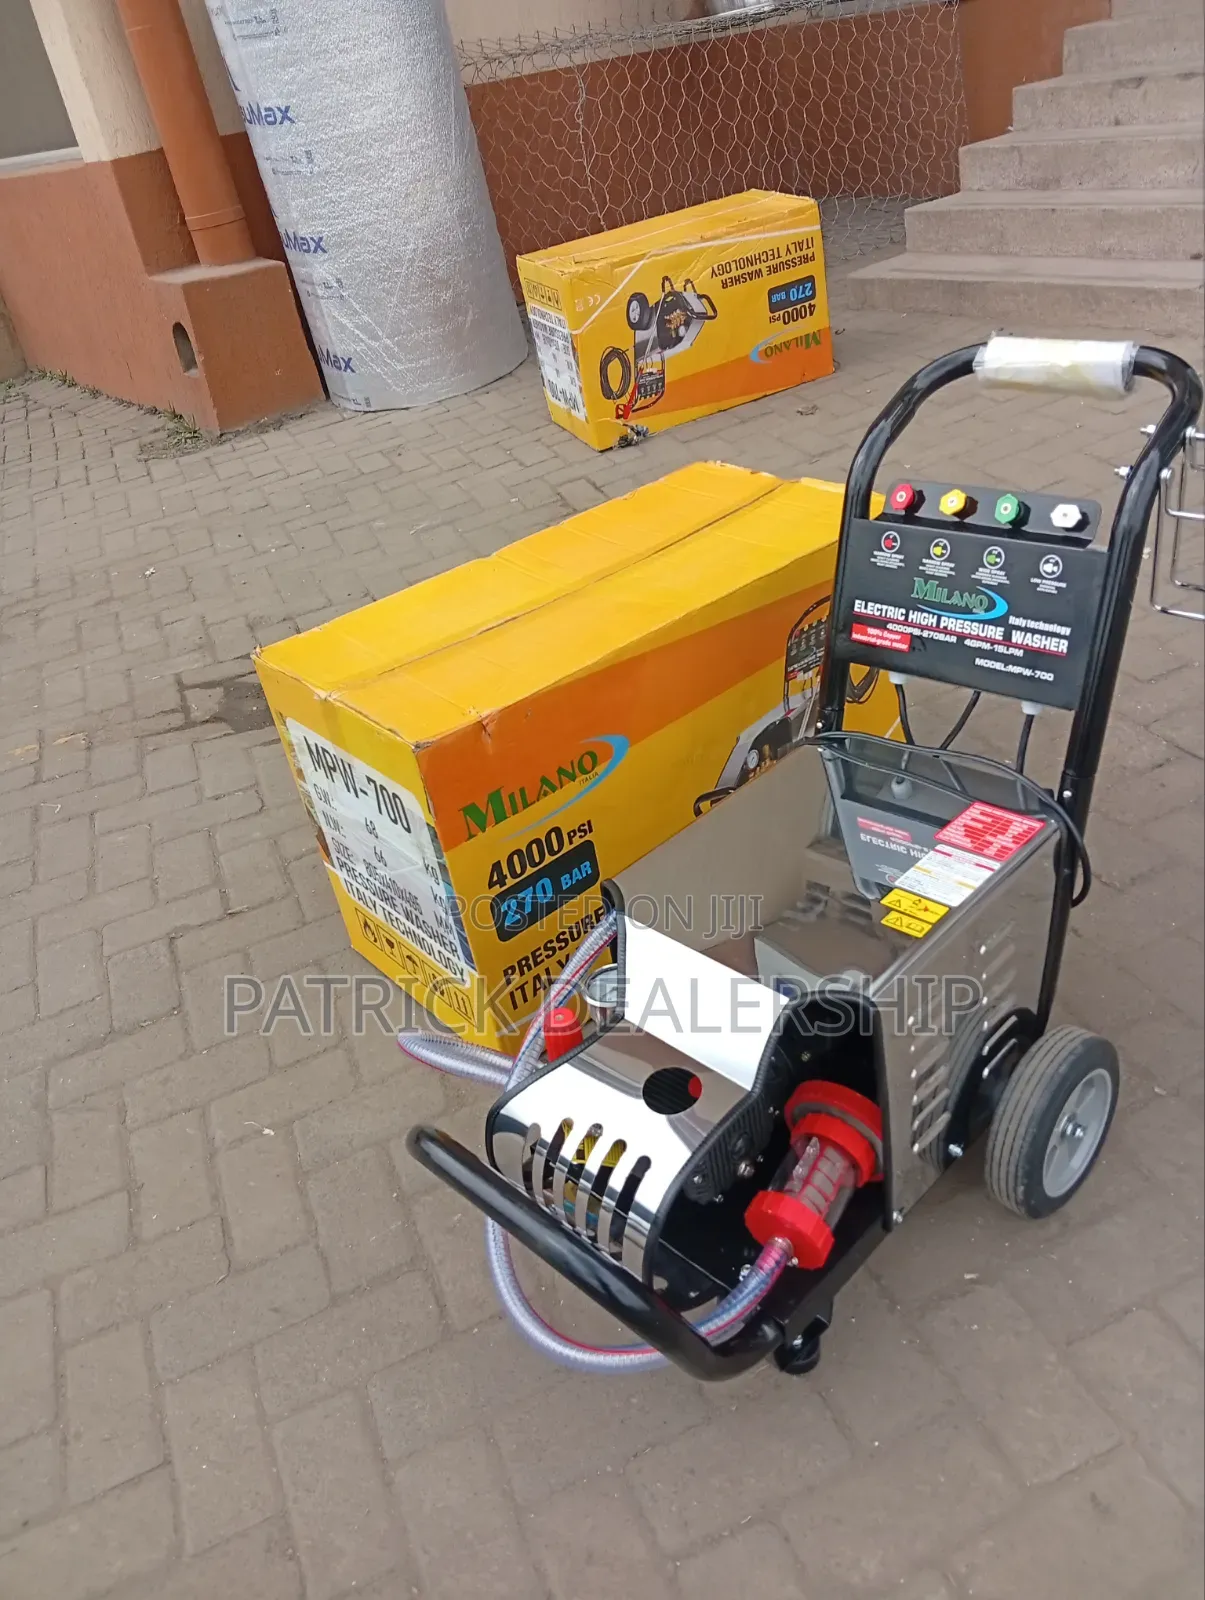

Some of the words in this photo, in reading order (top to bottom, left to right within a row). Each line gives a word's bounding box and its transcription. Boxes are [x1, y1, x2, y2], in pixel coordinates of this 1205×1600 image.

[785, 237, 814, 256] ITALY
[710, 246, 782, 279] TECHNOLOGY
[766, 251, 815, 276] PRESSURE
[720, 267, 764, 289] WASHER
[789, 282, 812, 302] 270
[771, 291, 786, 303] BAR
[769, 314, 781, 324] PSI
[782, 302, 816, 325] 4000
[764, 330, 822, 358] MILANO
[911, 577, 989, 611] MILANO
[854, 599, 906, 621] ELECTRIC
[908, 610, 938, 628] HIGH
[939, 616, 1005, 641] PRESSURE
[1011, 629, 1069, 654] WASHER
[1008, 615, 1027, 628] Italy
[1027, 619, 1072, 636] technology
[304, 735, 411, 834] MPW-700
[579, 771, 600, 786] ITALIA
[458, 750, 598, 843] MILANO
[365, 816, 378, 839] 68
[422, 857, 440, 886] kg
[373, 845, 387, 867] 66
[487, 826, 565, 890] 4000
[566, 819, 594, 845] PSI
[501, 877, 553, 926] 270
[560, 860, 593, 890] BAR
[336, 856, 400, 914] PRESSURE
[400, 902, 460, 961] WASHER
[343, 878, 379, 914] ITALY
[379, 904, 465, 982] TECHNOLOGY
